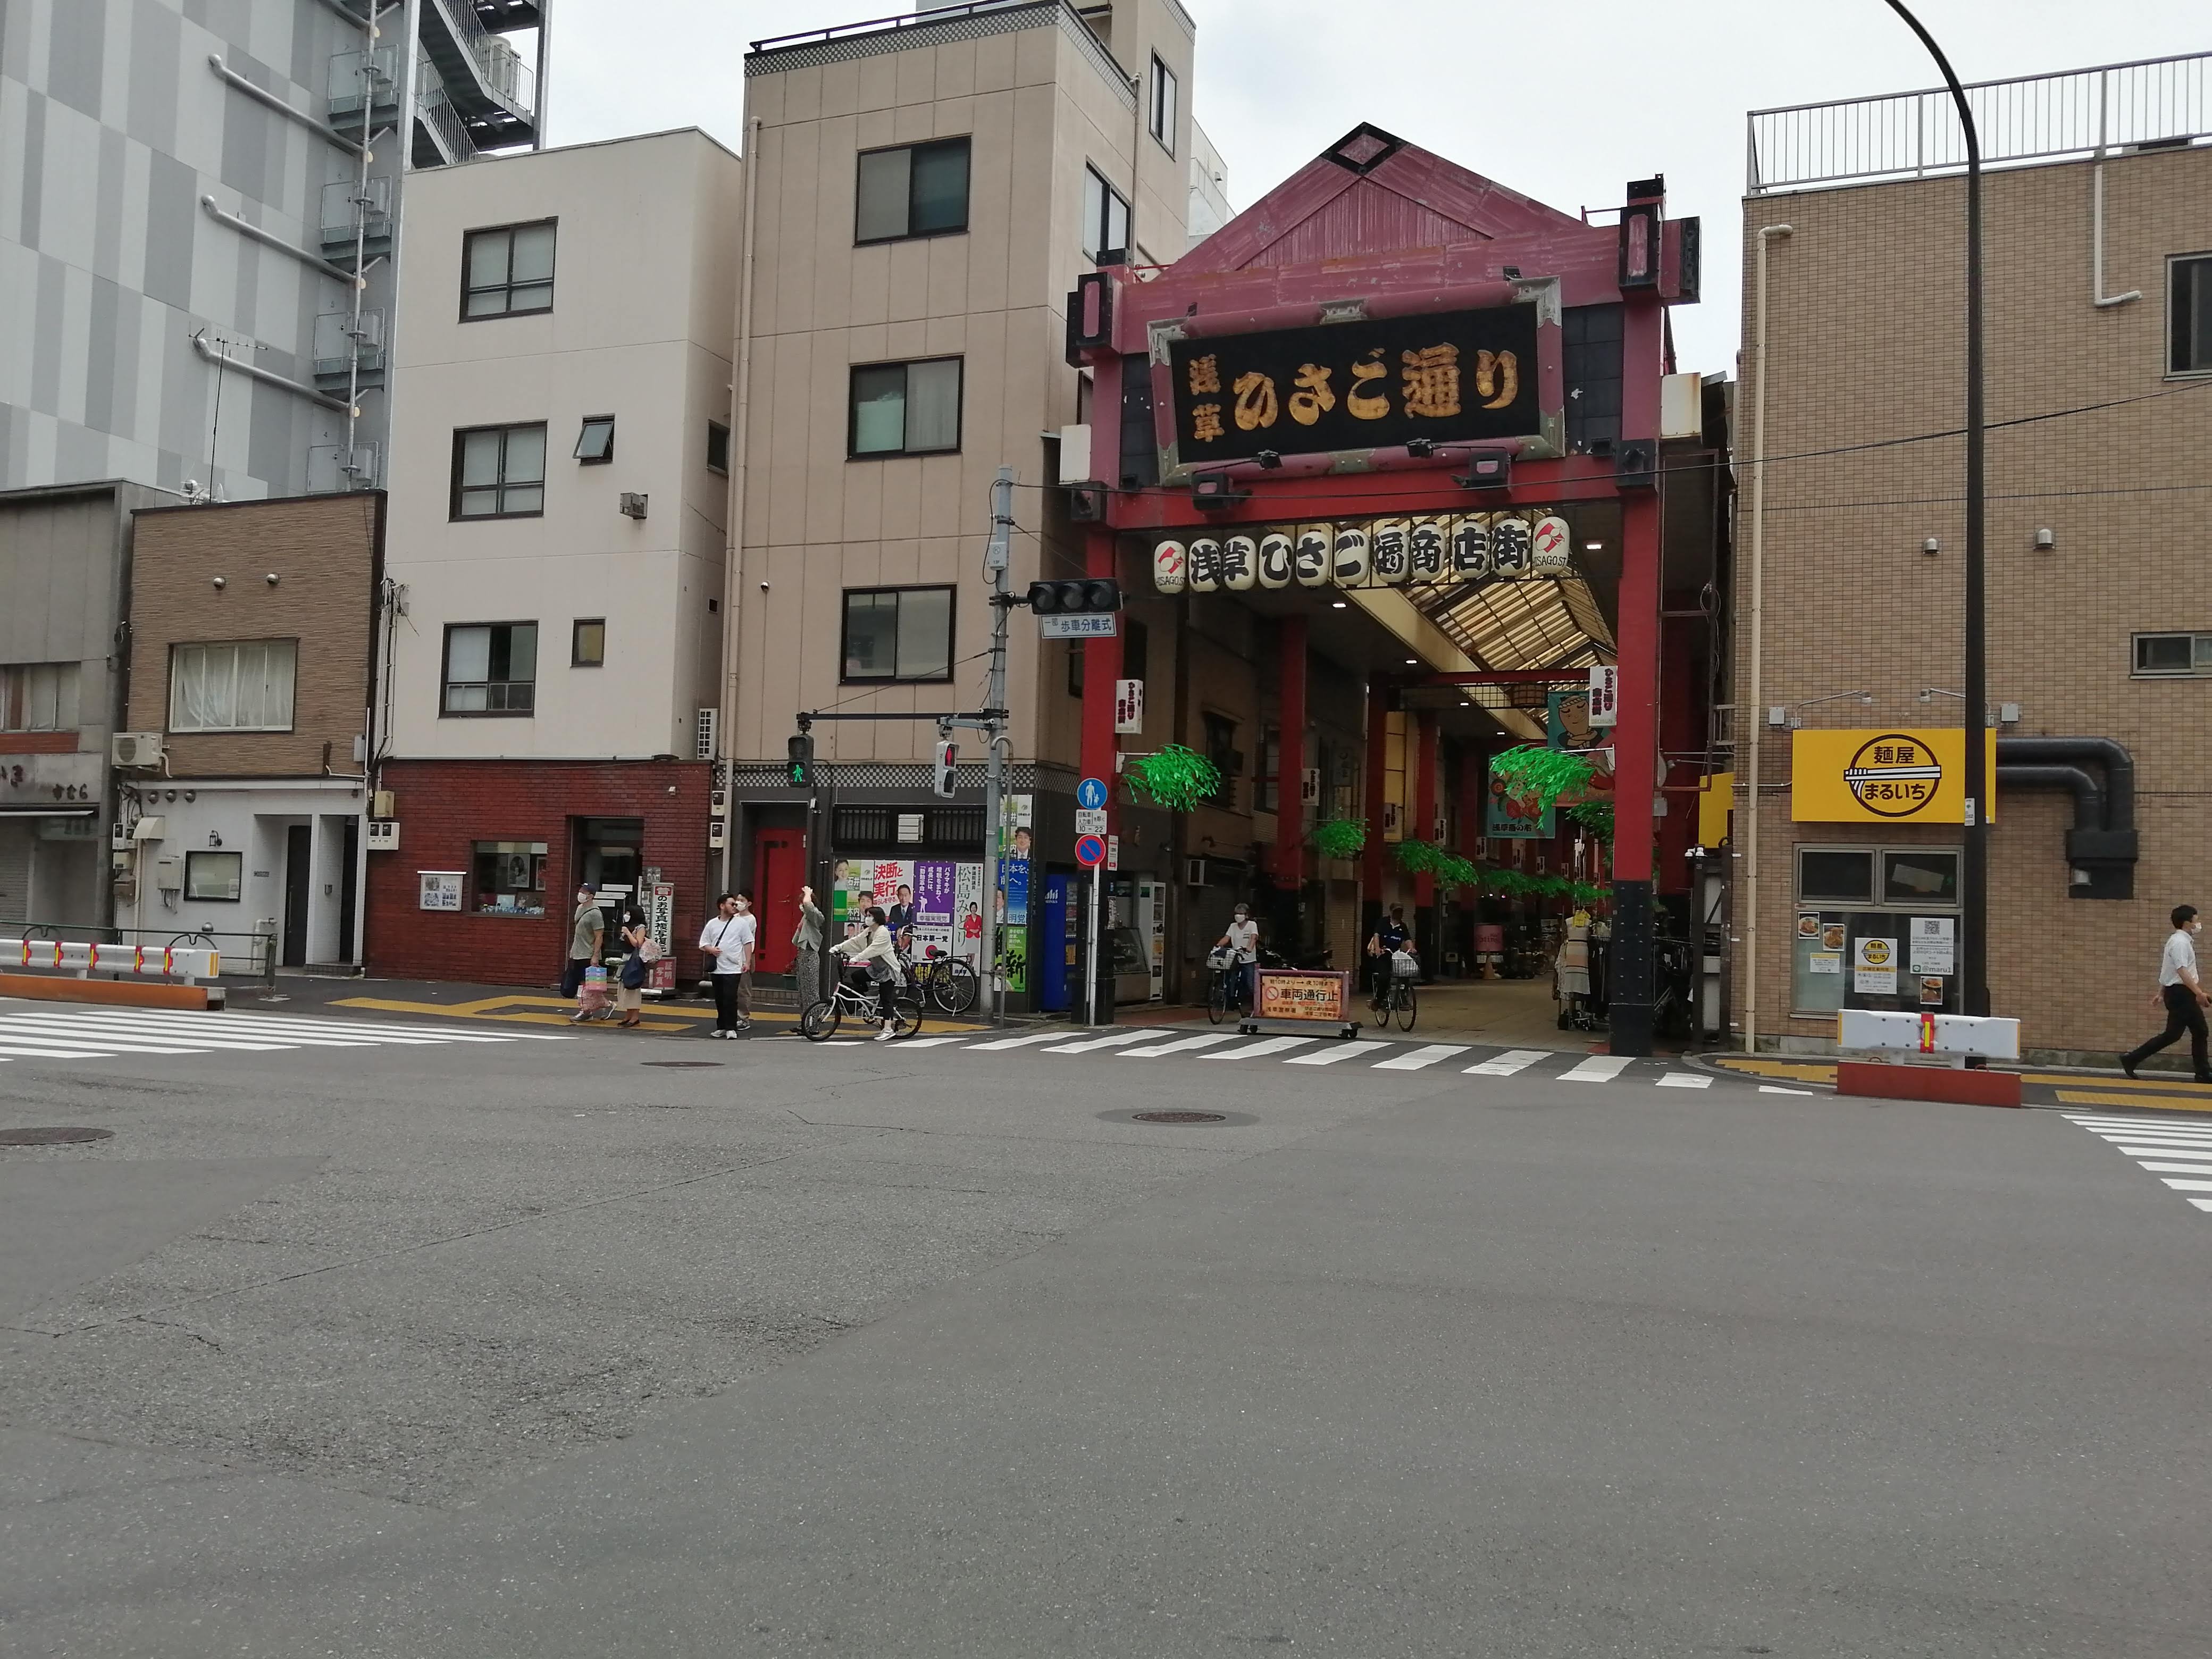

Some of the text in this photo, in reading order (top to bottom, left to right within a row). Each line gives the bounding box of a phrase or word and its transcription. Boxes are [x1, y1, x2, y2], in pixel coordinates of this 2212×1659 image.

[1232, 341, 1519, 431] ひさご通り
[1061, 619, 1111, 632] 歩車分離式
[1873, 745, 1915, 764] 麺屋
[1864, 783, 1925, 800] まるいち
[875, 861, 903, 881] 決断と
[847, 877, 860, 886] 石井
[847, 907, 860, 917] 木内
[1280, 988, 1338, 1001] 車両通行止
